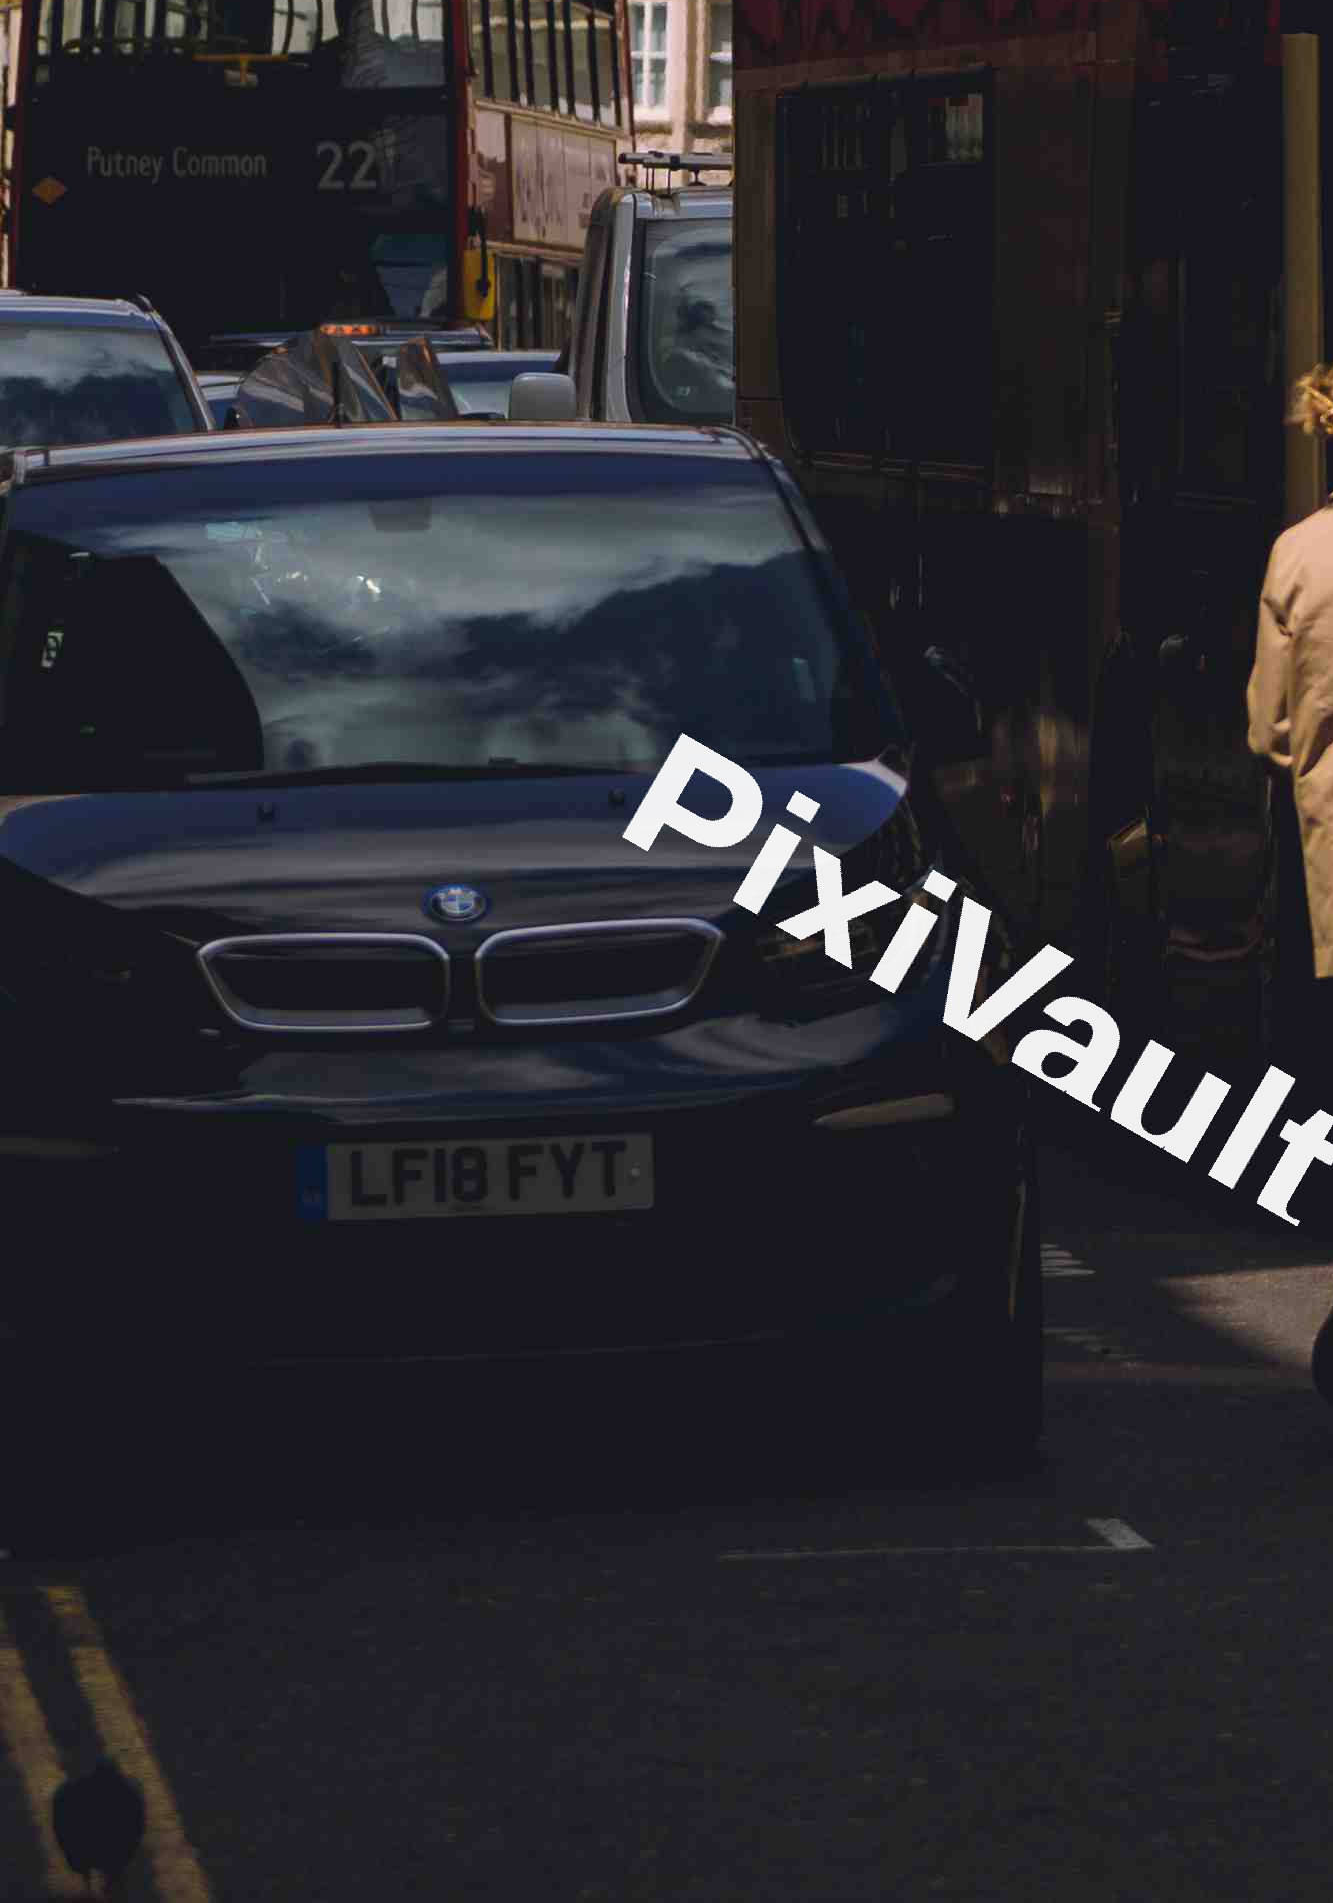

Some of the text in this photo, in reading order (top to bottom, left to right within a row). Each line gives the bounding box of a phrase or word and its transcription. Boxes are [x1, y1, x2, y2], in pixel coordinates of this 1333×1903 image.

[86, 145, 268, 185] Putney Common
[315, 139, 377, 190] 22
[349, 1140, 627, 1207] LF18 FYT
